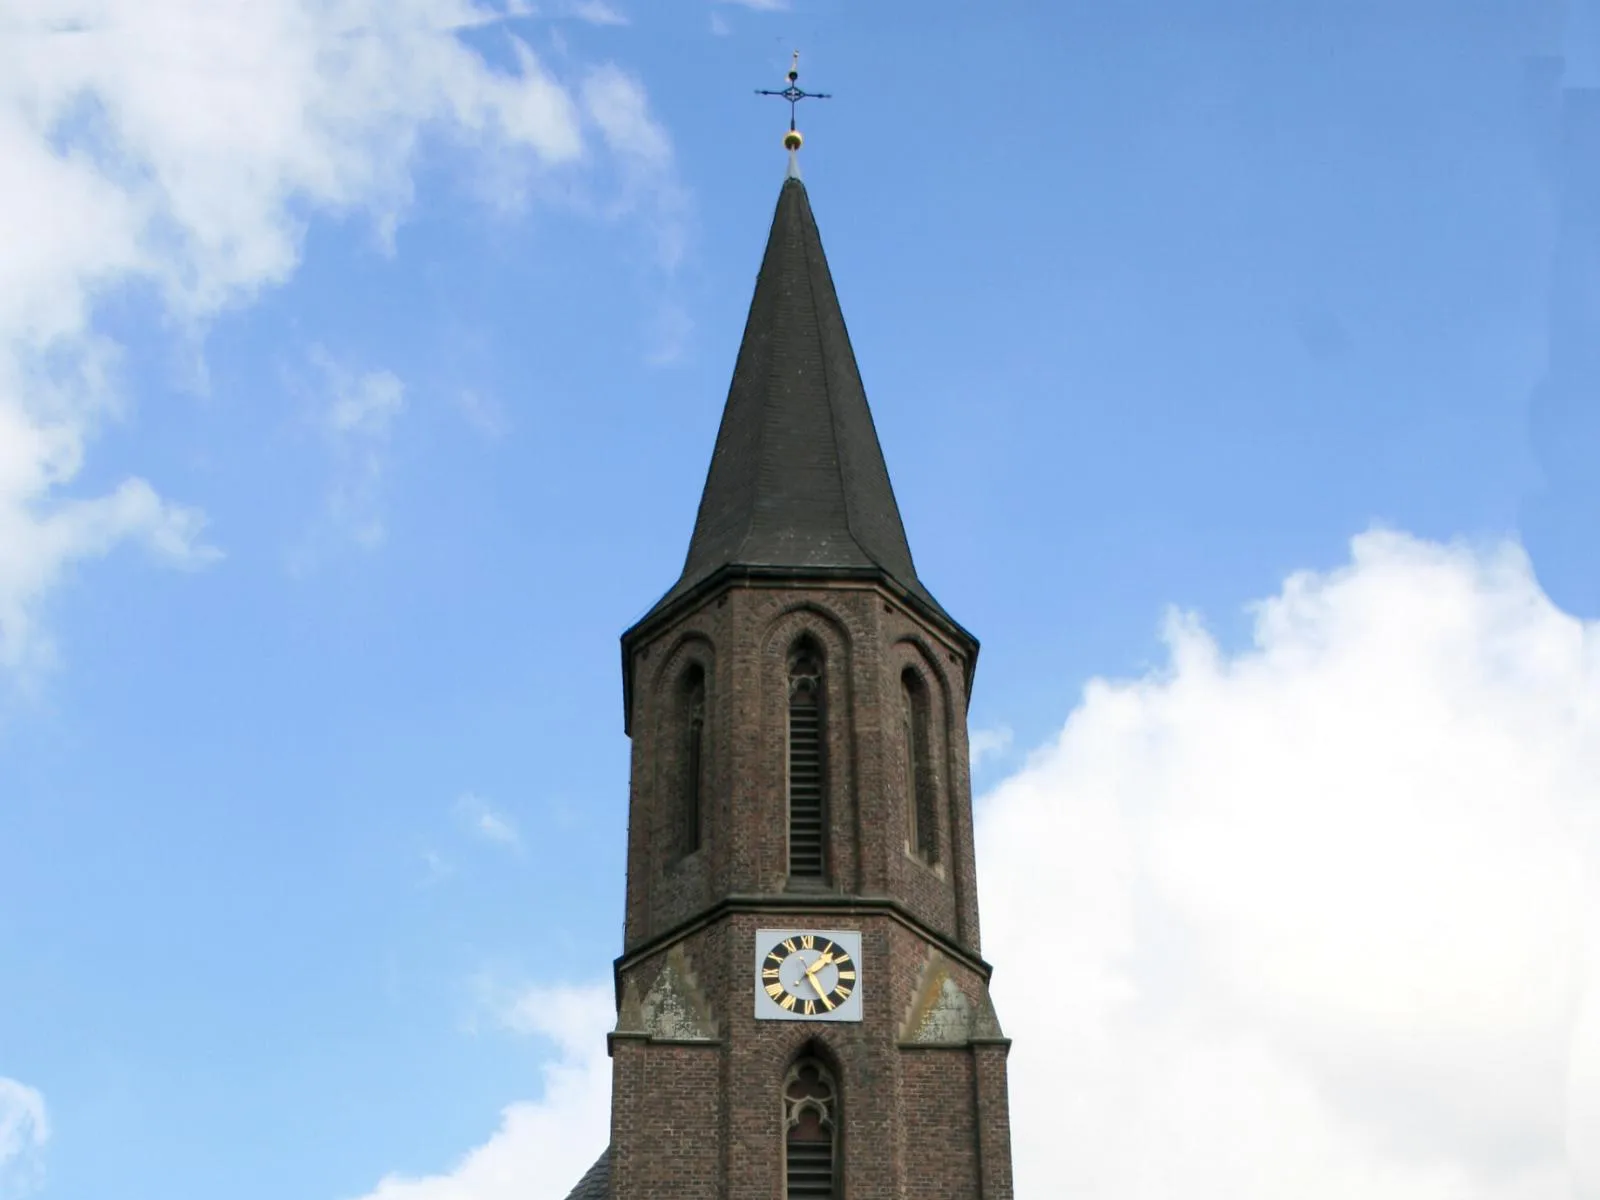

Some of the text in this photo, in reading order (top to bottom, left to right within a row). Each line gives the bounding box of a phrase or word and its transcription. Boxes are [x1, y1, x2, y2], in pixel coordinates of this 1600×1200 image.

[782, 939, 796, 953] XI
[801, 936, 813, 949] XII
[824, 941, 833, 953] I
[768, 952, 783, 963] X
[762, 969, 779, 977] IX
[805, 1000, 816, 1014] VI
